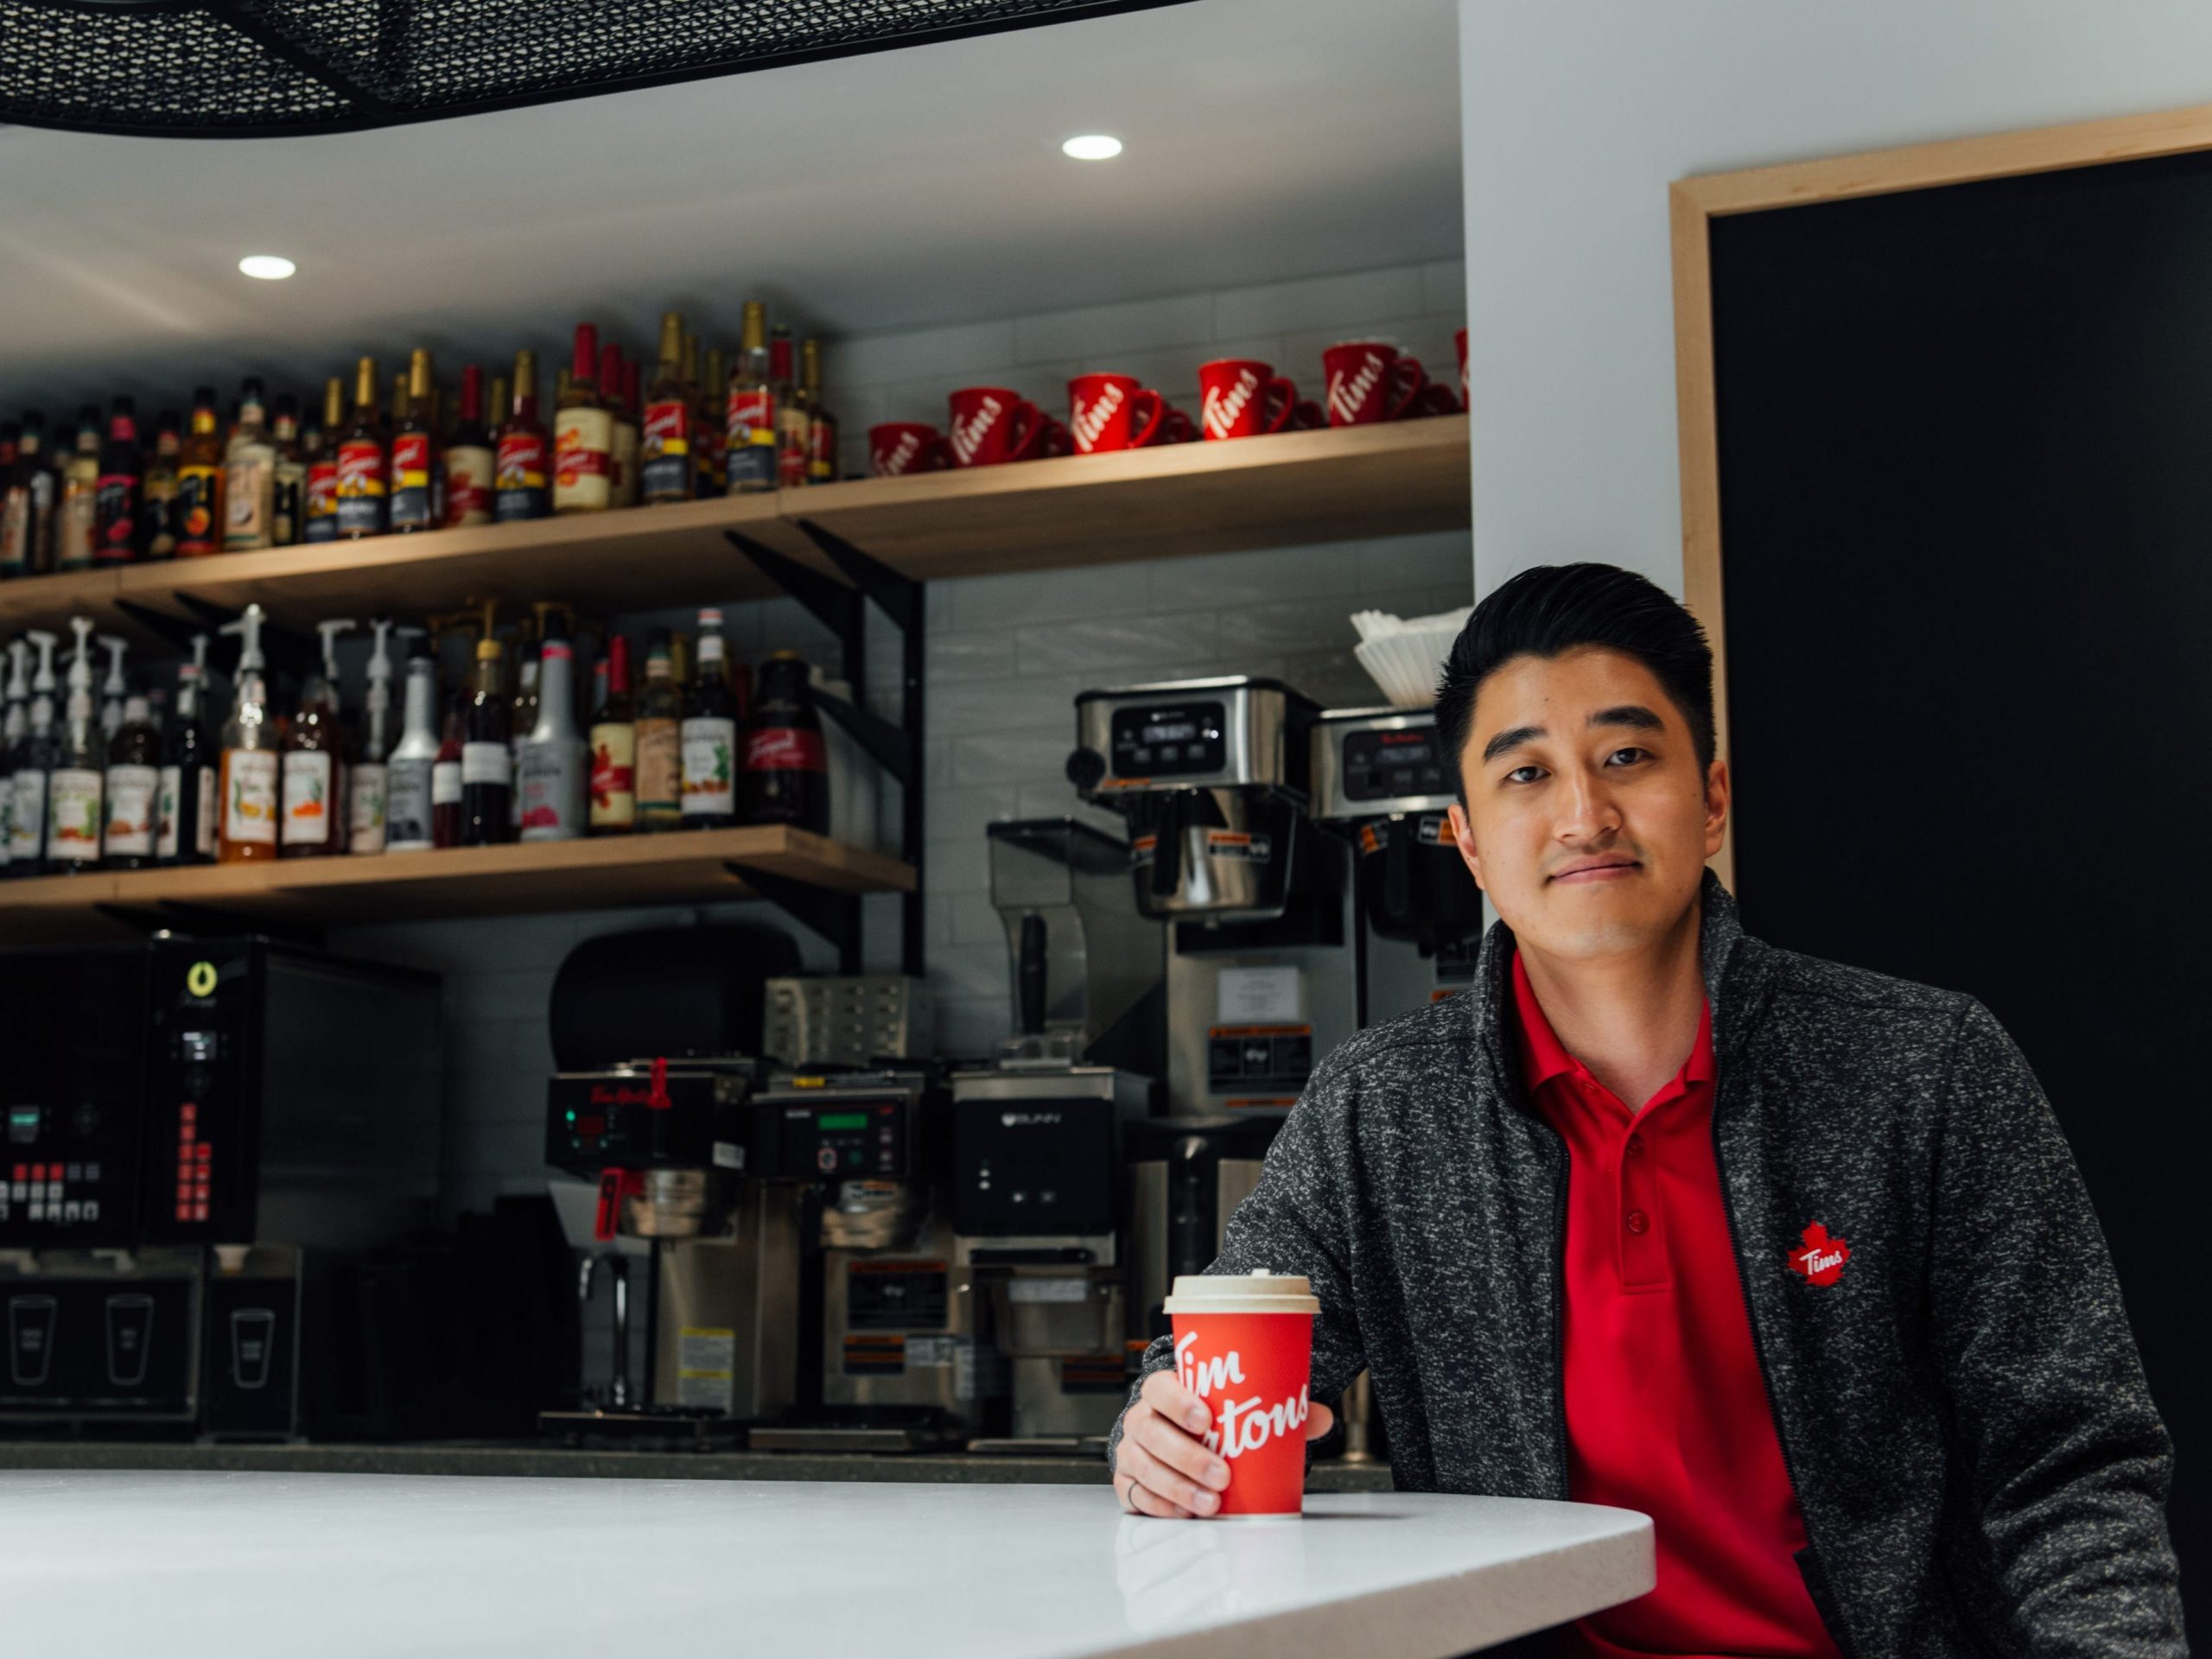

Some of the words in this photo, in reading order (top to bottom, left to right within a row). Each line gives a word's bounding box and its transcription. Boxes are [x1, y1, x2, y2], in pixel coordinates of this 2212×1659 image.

[1071, 382, 1124, 453] Tims
[1201, 368, 1259, 439] Tims
[1327, 352, 1383, 423] Tims
[951, 395, 1002, 465] Tims
[1799, 1248, 1843, 1275] Tims
